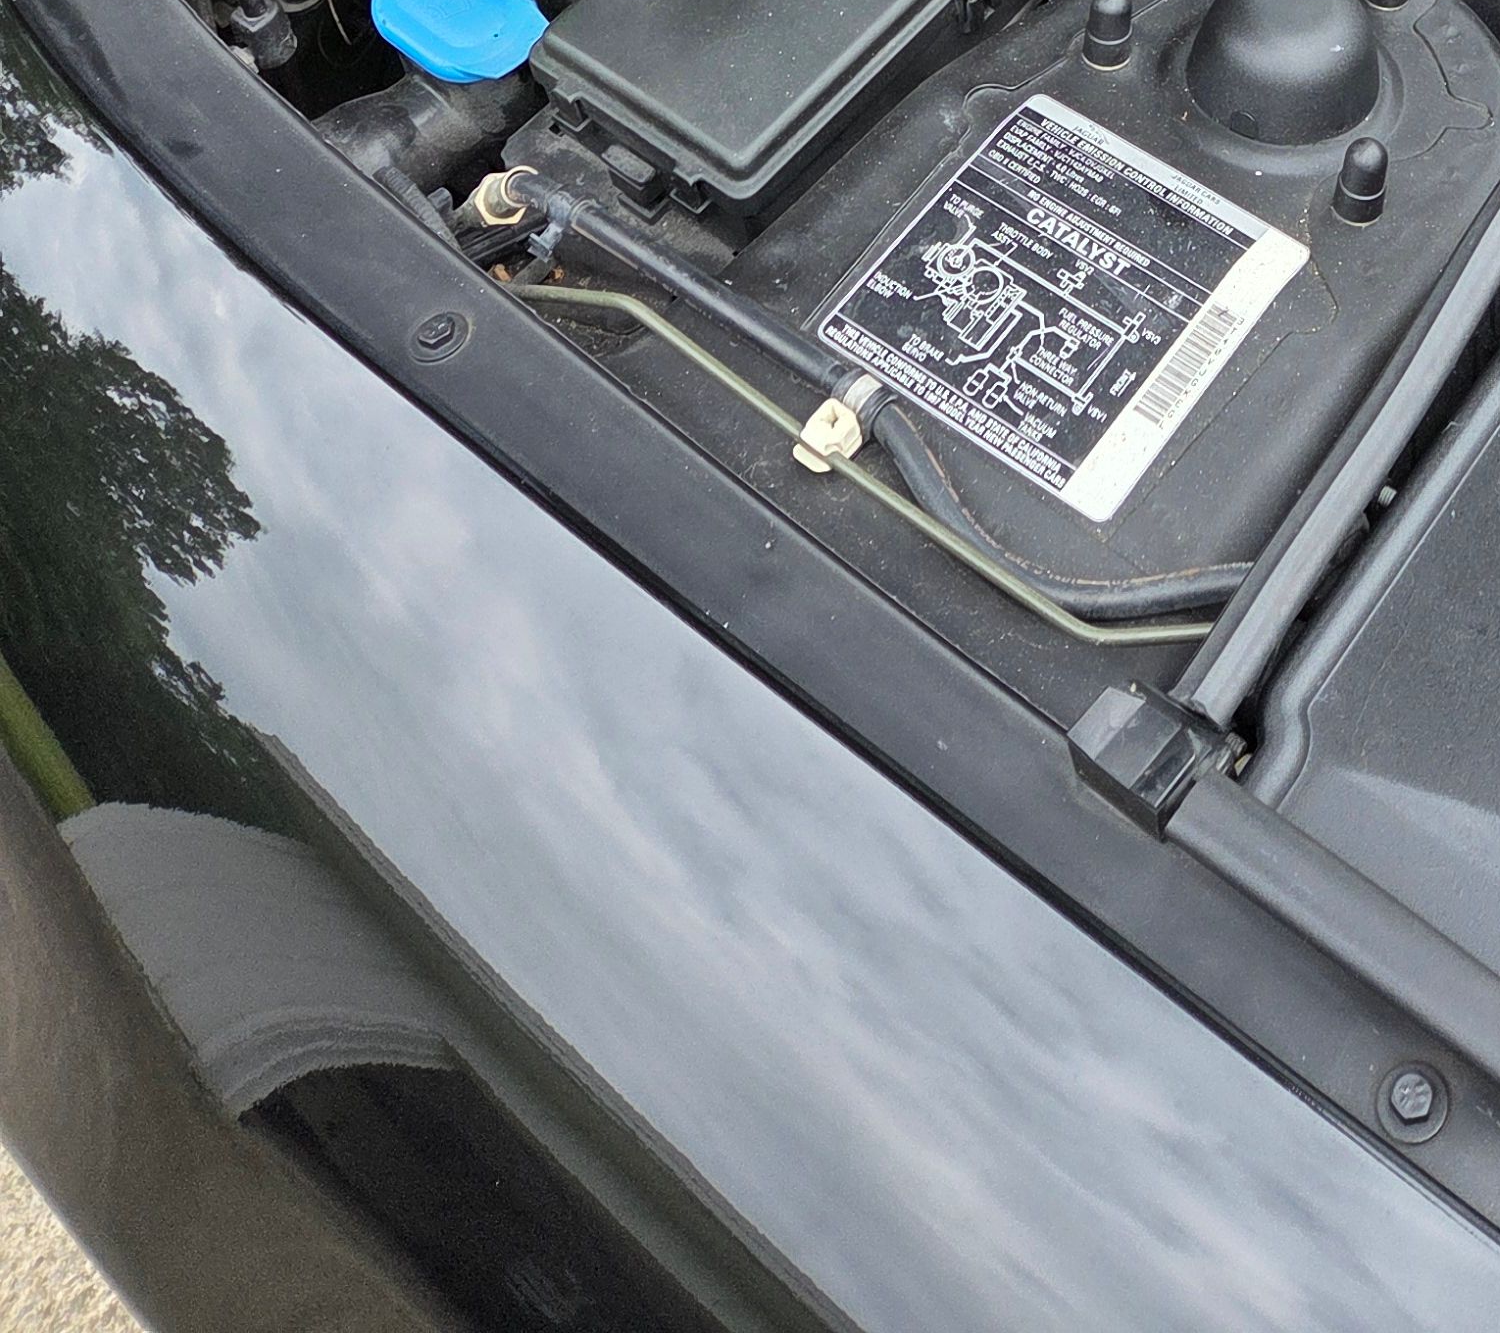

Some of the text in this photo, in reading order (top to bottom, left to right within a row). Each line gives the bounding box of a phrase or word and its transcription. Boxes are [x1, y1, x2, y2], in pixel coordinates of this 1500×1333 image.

[1002, 131, 1053, 164] DISPLACEMENT
[1009, 124, 1029, 138] EVAP
[1025, 133, 1052, 152] FAMILY
[1015, 118, 1042, 136] ENGINE
[1040, 132, 1066, 150] FAMILY
[1072, 124, 1104, 146] JAGUAR
[987, 148, 1005, 162] OBD
[1006, 159, 1042, 184] CERTIFIED
[995, 138, 1029, 162] EXHAUST
[1048, 169, 1067, 184] TWC
[1088, 193, 1108, 208] EGR
[1039, 118, 1234, 236] VEHICLE EMISSION CONTROL INFORMATION
[1171, 173, 1221, 205] JAGUAR CARS
[1173, 184, 1204, 205] LIMITED
[940, 200, 965, 219] VALVE
[947, 193, 986, 219] TO PURGE
[989, 229, 1012, 246] ASSY
[996, 221, 1054, 260] THROTTLE BODY
[1023, 205, 1132, 279] CATALYST
[1025, 189, 1151, 268] NO ENGINE ADJUSTMENT REQUIRED
[1072, 258, 1095, 276] VSV2
[864, 277, 894, 300] ELBOW
[872, 270, 913, 300] INDUCTION
[1057, 306, 1116, 347] FUEL PRESSURE
[1057, 318, 1103, 351] REGULATOR
[1138, 327, 1162, 346] VSV3
[899, 340, 928, 363] SERVO
[906, 332, 946, 362] TO BRAKE
[1034, 344, 1078, 377] THREE WAY
[1027, 352, 1075, 387] CONNECTOR
[823, 323, 875, 362] REGULATIONS
[869, 354, 916, 389] APPLICABLE
[911, 382, 927, 396] TO
[937, 399, 967, 423] MODEL
[962, 415, 986, 436] YEAR
[981, 428, 1005, 448] NEW
[1000, 440, 1047, 476] PASSENGER
[1041, 467, 1067, 489] CARS
[839, 323, 861, 341] THIS
[856, 333, 889, 359] VEHICLE
[884, 351, 928, 385] CONFORMS
[922, 377, 938, 391] TO
[967, 406, 989, 424] AND
[983, 417, 1011, 439] STATE
[1014, 436, 1063, 474] CALIFORNIA
[1010, 388, 1037, 410] VALVE
[1017, 379, 1069, 418] NON-RETURN
[1084, 403, 1109, 423] VSV1
[1015, 420, 1044, 443] TANKS
[1021, 411, 1058, 440] VACUUM
